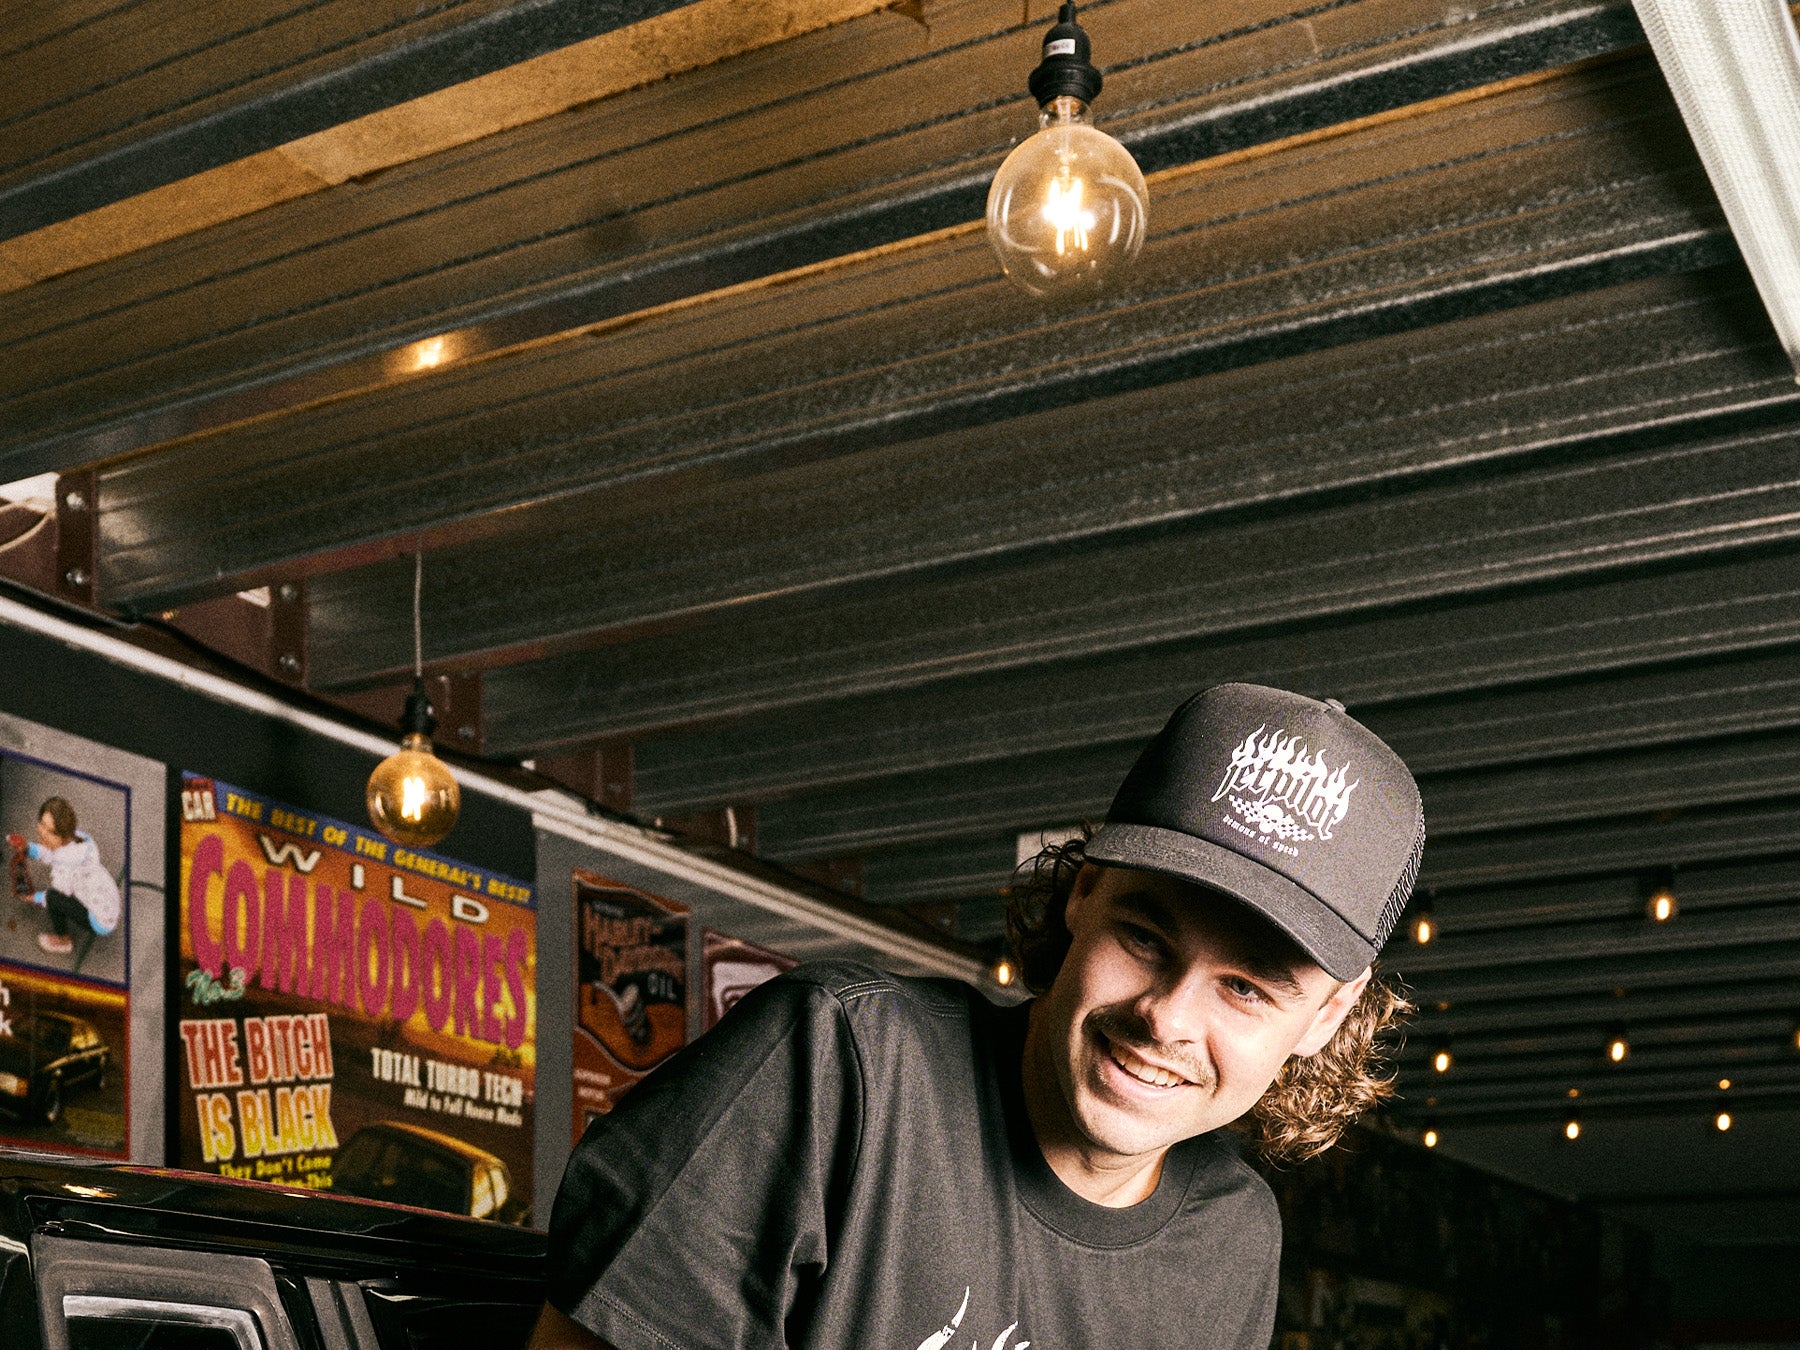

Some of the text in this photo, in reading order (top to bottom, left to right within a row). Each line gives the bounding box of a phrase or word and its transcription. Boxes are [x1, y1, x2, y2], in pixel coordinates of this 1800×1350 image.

[181, 790, 217, 822] CAR
[226, 793, 263, 820] THE
[271, 809, 317, 836] BEST
[323, 826, 348, 846] OF
[355, 836, 387, 861] THE
[1259, 835, 1271, 845] of
[260, 833, 490, 924] WILD
[189, 833, 530, 1049] COMMODORES
[647, 972, 678, 1000] OIL
[180, 1013, 335, 1089] THE BITCH
[371, 1047, 523, 1107] TOTAL TURBO TECH
[196, 1092, 237, 1163] IS
[237, 1083, 339, 1158] BLACK
